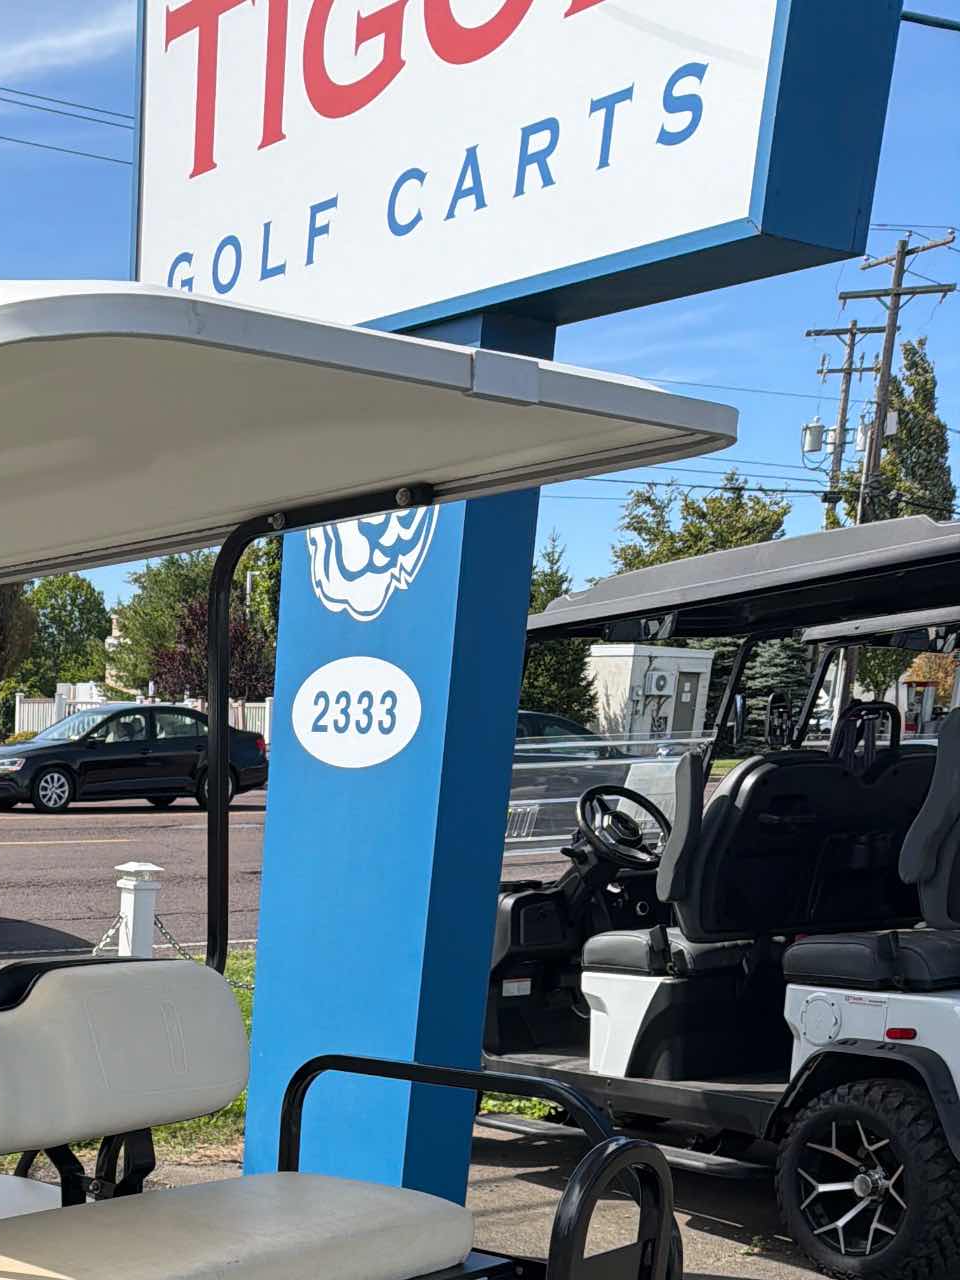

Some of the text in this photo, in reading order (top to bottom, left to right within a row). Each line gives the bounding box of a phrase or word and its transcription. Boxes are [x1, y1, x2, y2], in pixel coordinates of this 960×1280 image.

[167, 62, 709, 294] GOLF CARTS
[311, 690, 398, 735] 2333
